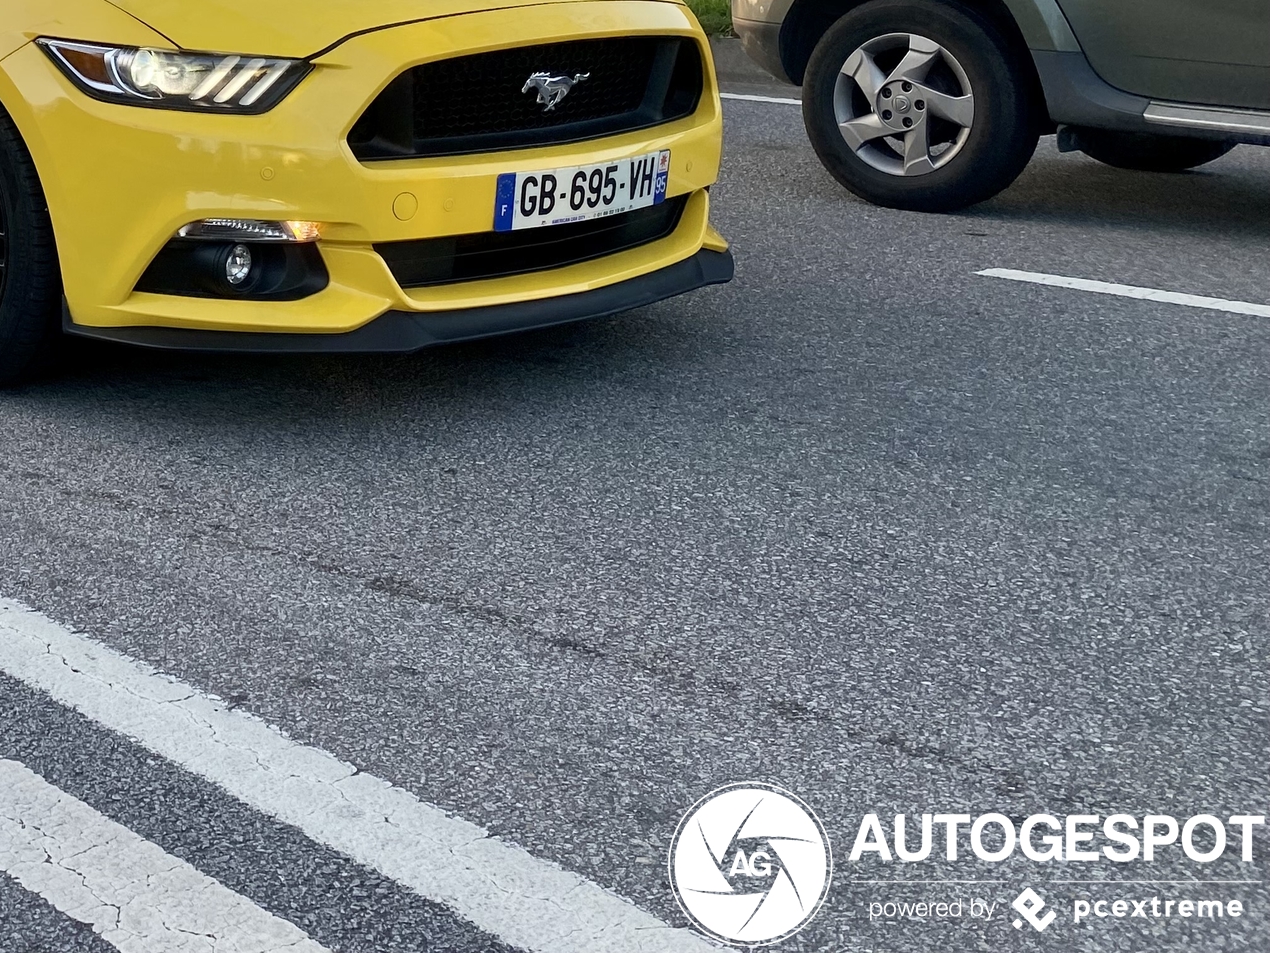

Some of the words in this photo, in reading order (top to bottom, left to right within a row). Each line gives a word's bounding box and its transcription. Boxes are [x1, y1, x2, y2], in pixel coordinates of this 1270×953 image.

[520, 157, 656, 217] GB-695-VH
[655, 175, 667, 195] 95
[501, 204, 508, 217] F
